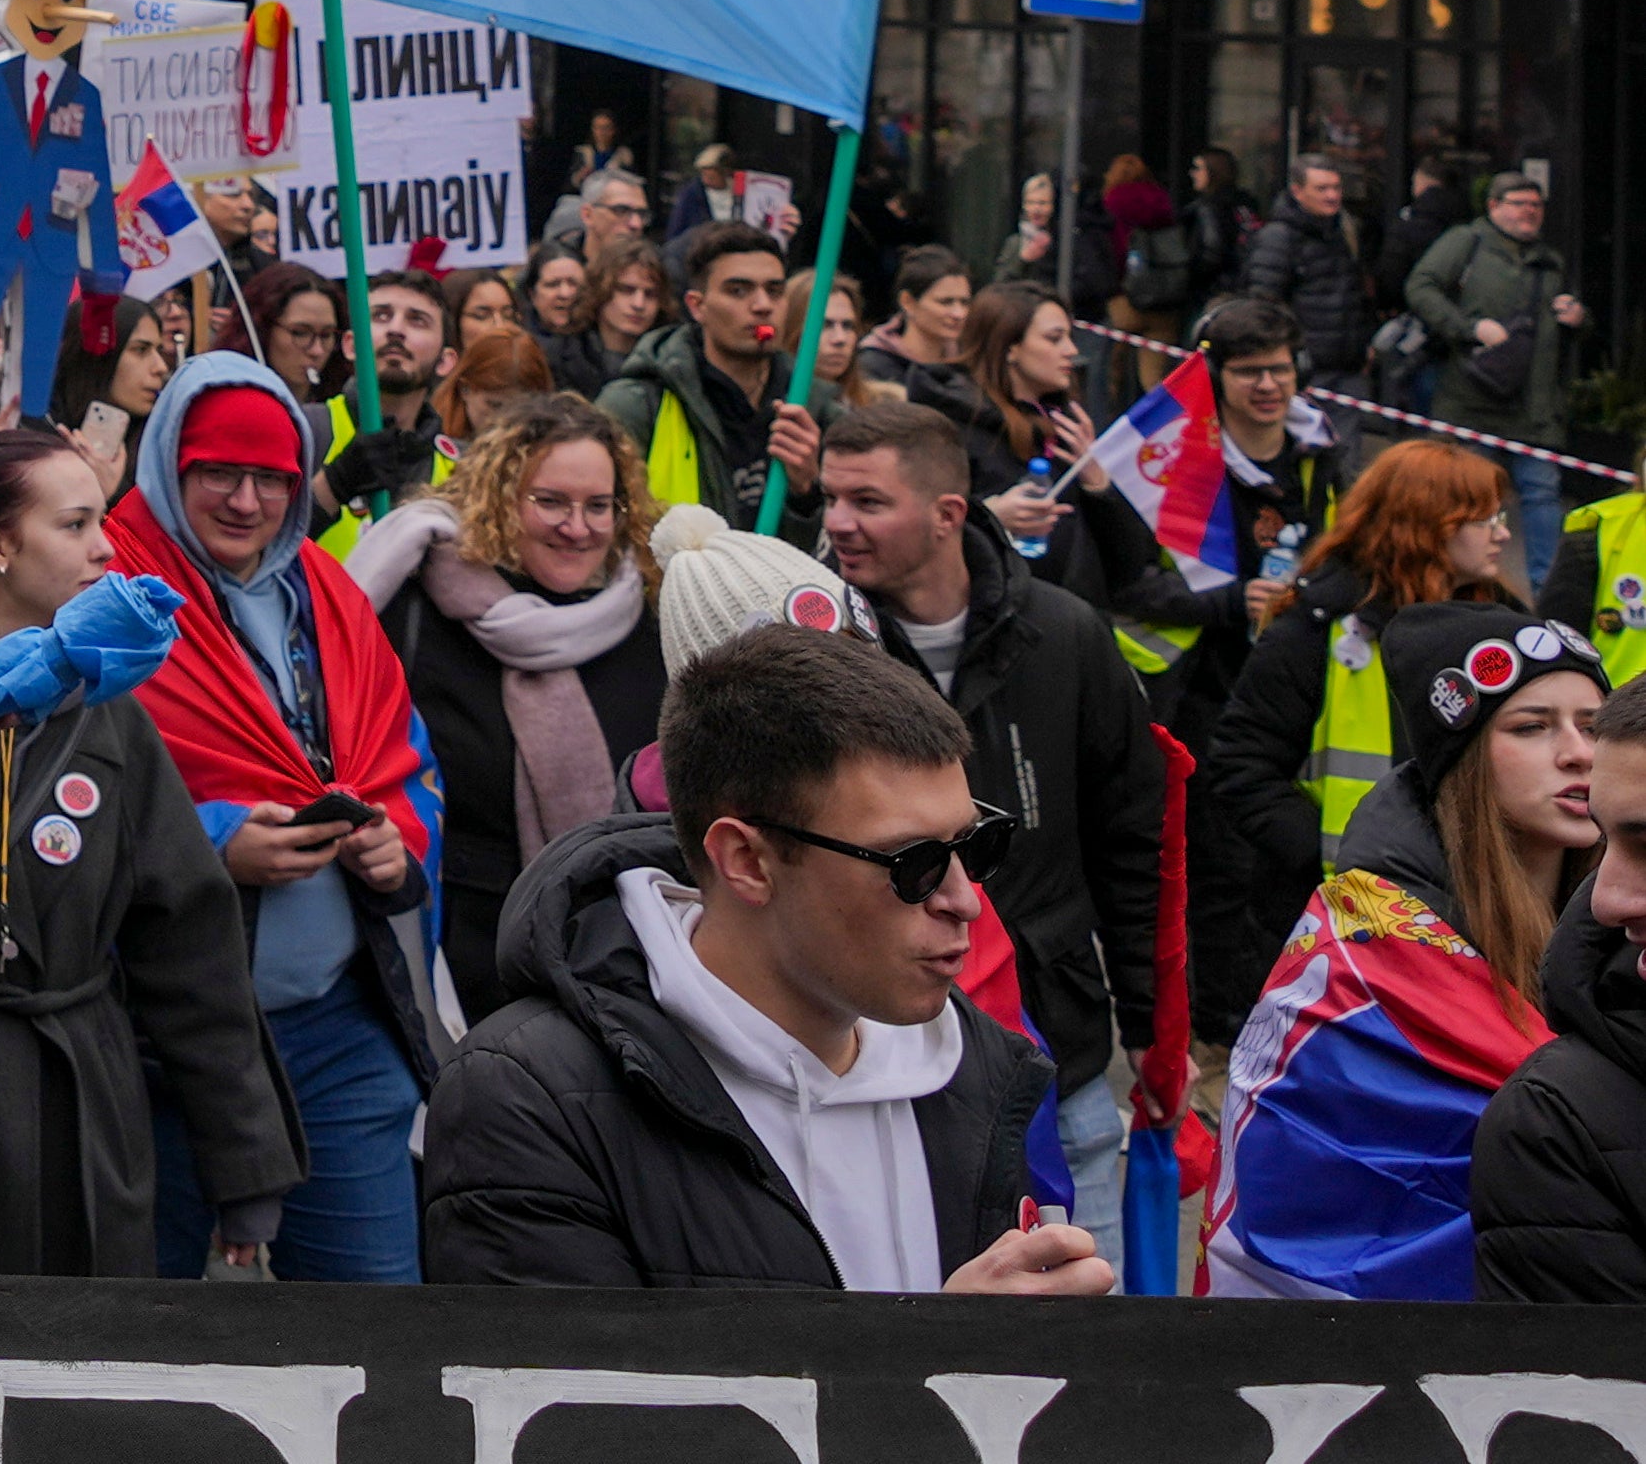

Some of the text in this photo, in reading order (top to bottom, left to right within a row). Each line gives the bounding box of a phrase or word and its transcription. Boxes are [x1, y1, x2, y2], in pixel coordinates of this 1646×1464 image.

[133, 0, 179, 25] СВЕ
[110, 55, 156, 103] ТИ
[164, 50, 199, 101] СИ
[287, 159, 511, 253] капирају
